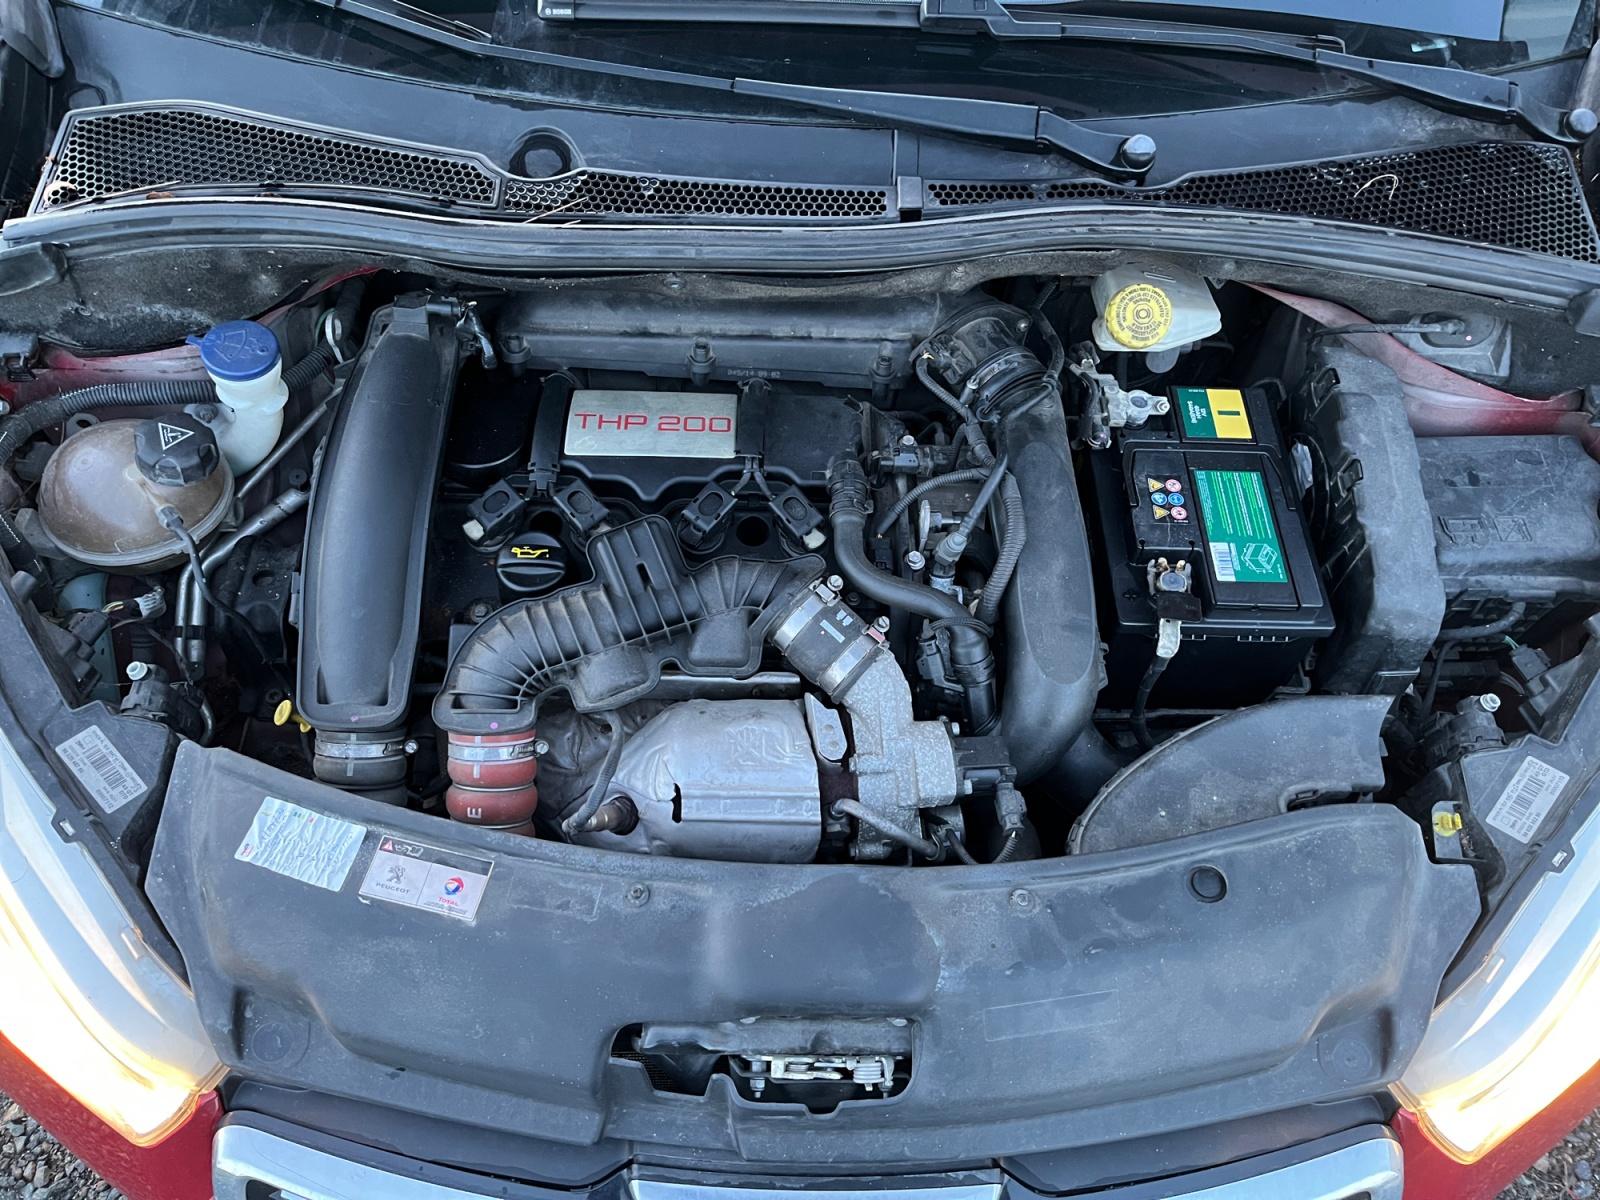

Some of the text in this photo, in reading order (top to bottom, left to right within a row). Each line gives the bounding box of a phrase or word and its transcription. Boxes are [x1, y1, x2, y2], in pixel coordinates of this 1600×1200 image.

[574, 413, 732, 433] THP 200
[375, 882, 410, 894] PEUGEOT
[438, 897, 459, 907] TOTAL
